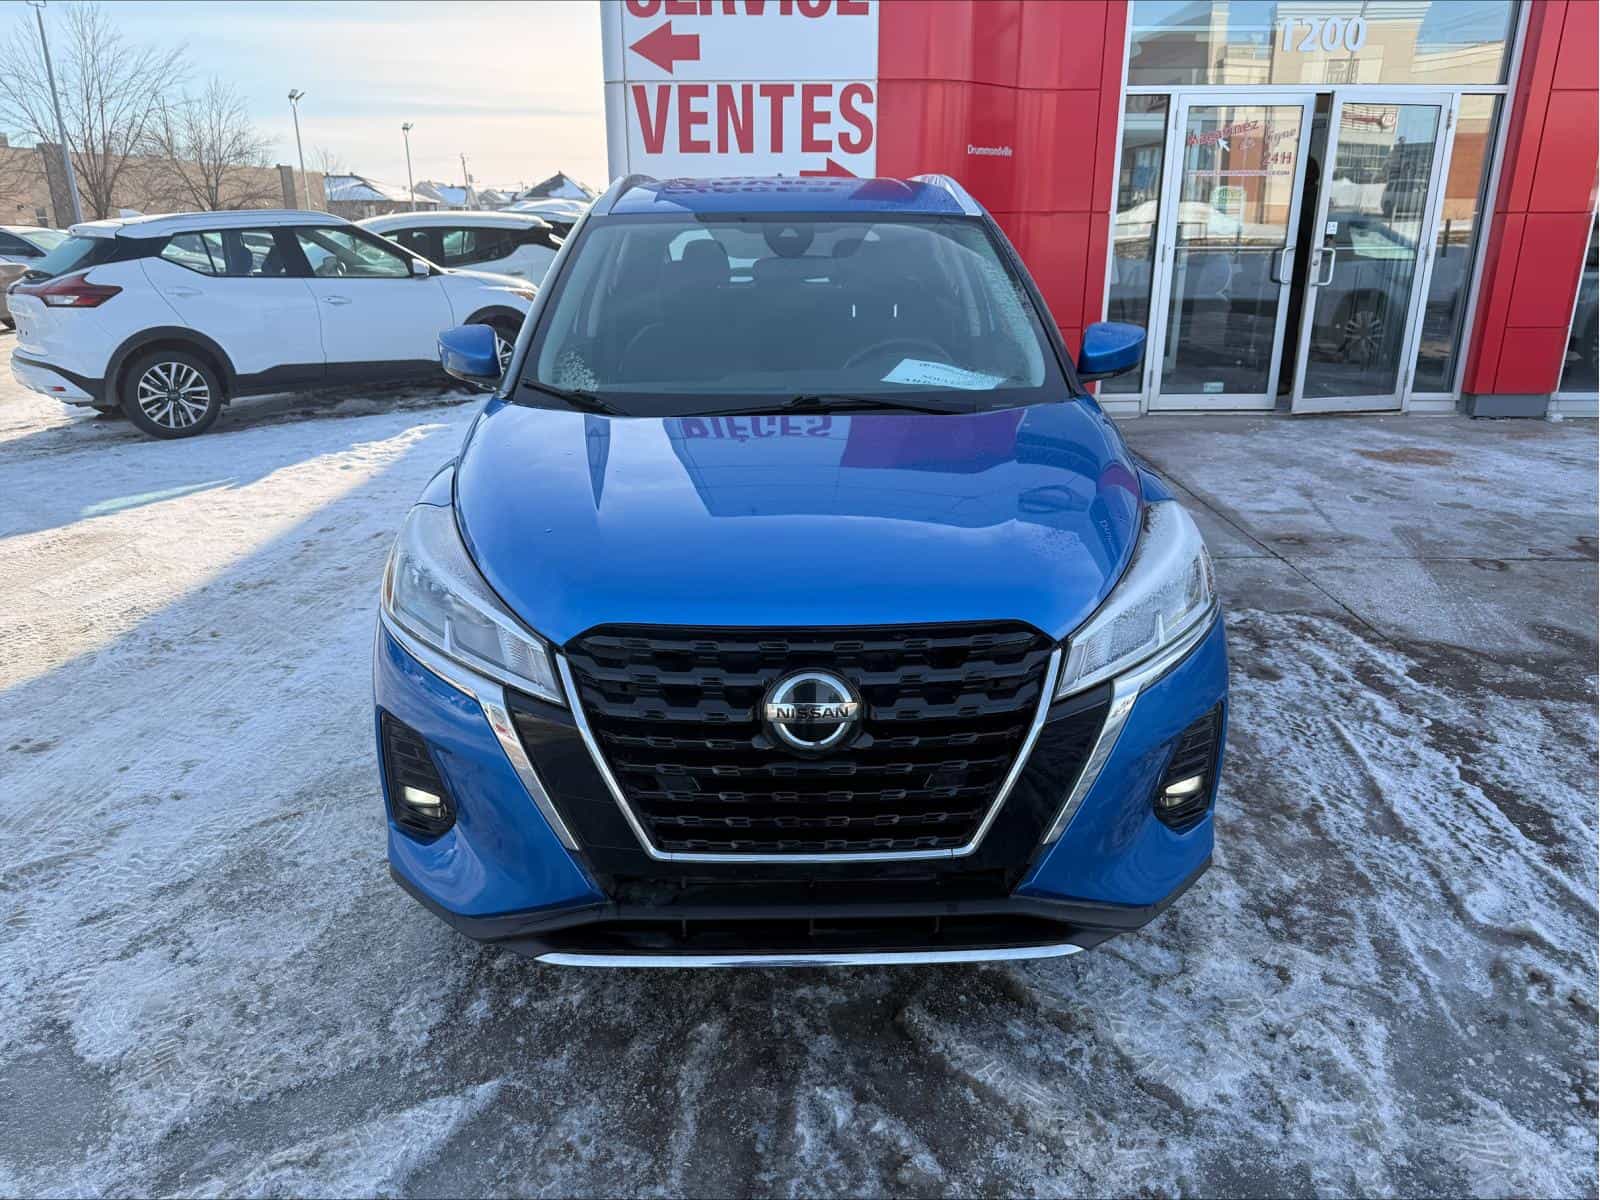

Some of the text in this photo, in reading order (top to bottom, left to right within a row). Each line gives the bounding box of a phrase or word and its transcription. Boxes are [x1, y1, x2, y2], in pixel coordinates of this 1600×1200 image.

[1279, 16, 1366, 52] 1200
[631, 83, 874, 155] VENTES
[776, 707, 849, 719] NISSAN
